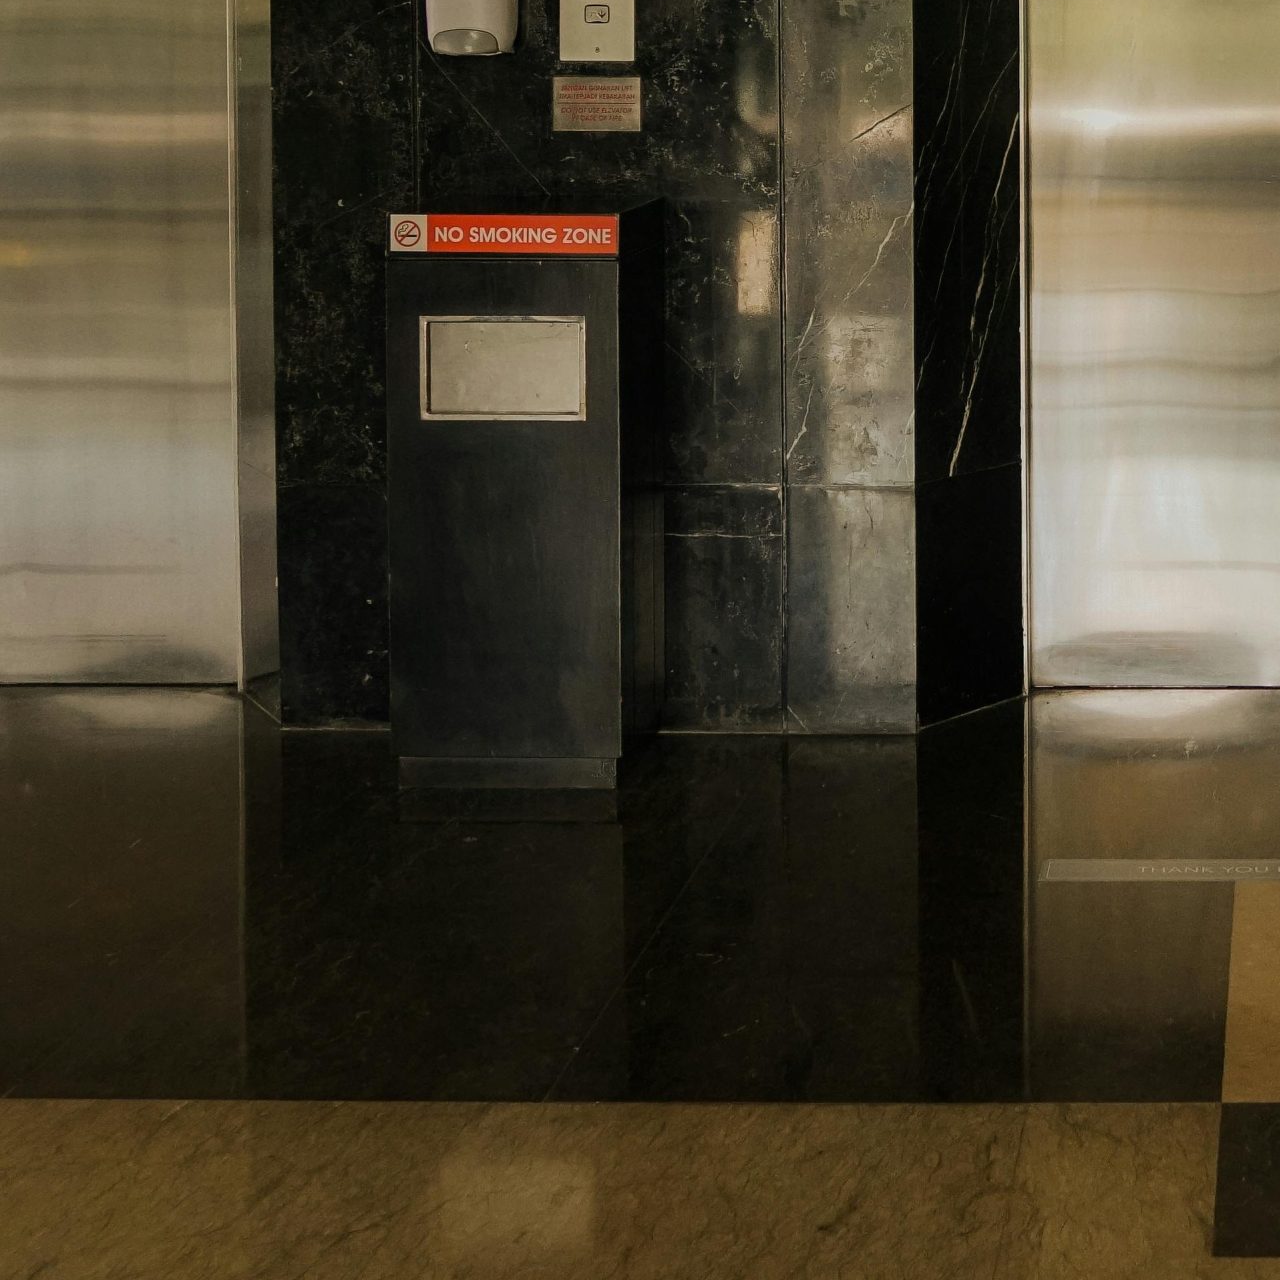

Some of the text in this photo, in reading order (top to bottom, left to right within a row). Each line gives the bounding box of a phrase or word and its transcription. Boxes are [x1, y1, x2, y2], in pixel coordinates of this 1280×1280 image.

[434, 226, 611, 245] NO SMOKING ZONE
[1137, 865, 1213, 874] THANK
[1222, 865, 1269, 874] YOU
